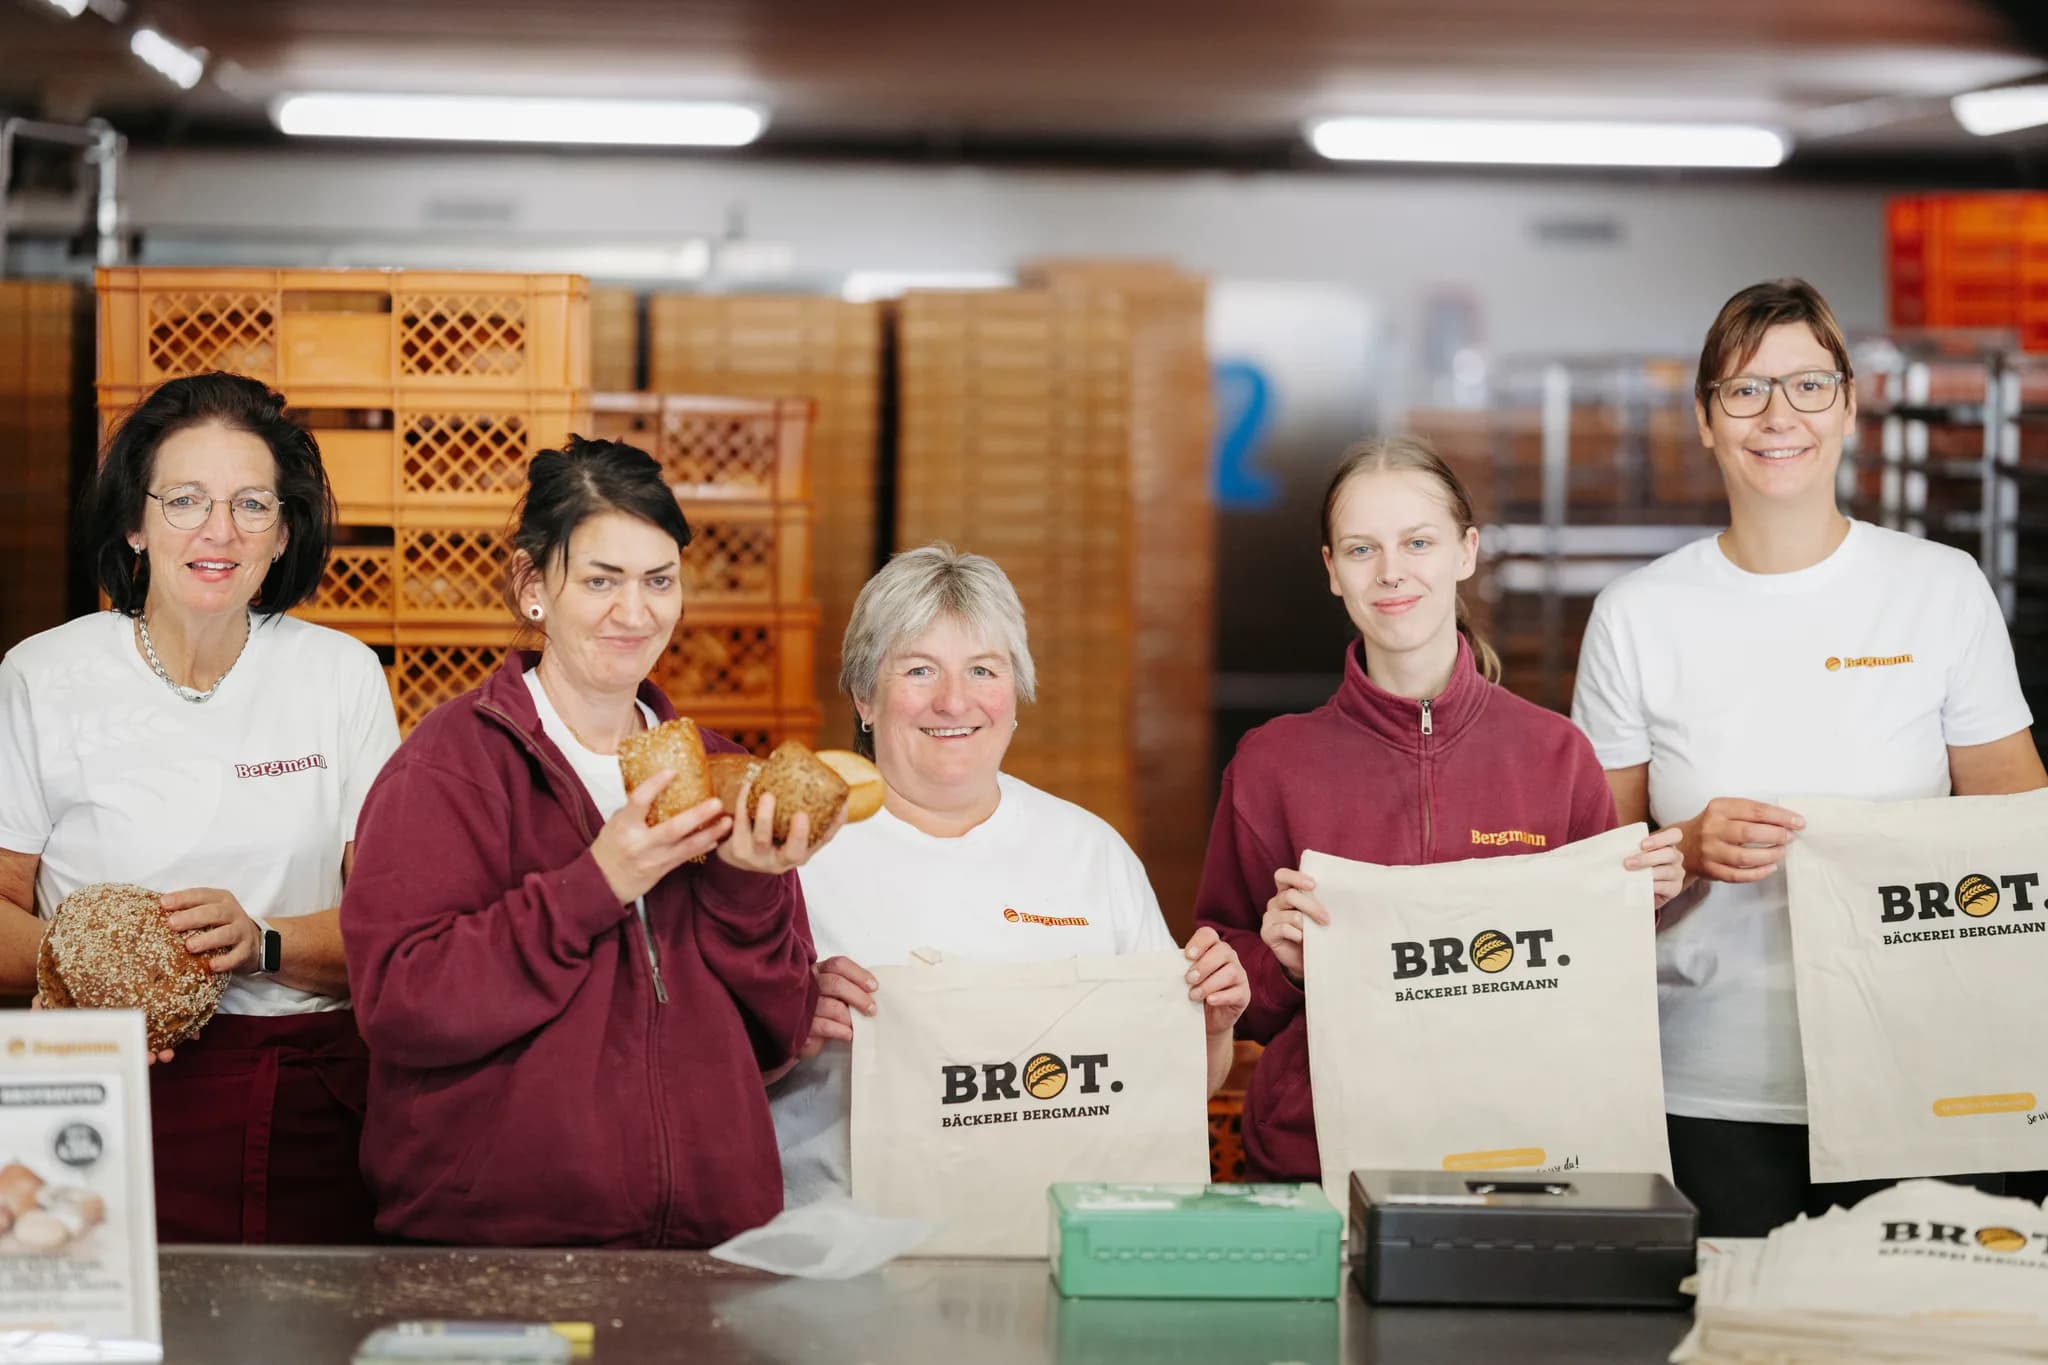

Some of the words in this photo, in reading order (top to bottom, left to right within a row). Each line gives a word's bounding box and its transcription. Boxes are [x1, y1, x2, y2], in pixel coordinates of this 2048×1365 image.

[1020, 912, 1088, 926] Bergmann
[1883, 928, 1955, 945] BÄCKEREI
[1959, 921, 2046, 938] BERGMANN
[1391, 929, 1571, 980] BROT.
[1395, 985, 1468, 1002] BÄCKEREI
[1472, 978, 1559, 995] BERGMANN
[941, 1052, 1124, 1105] BROT.
[942, 1111, 1018, 1128] BÄCKEREI
[1023, 1104, 1110, 1121] BERGMANN
